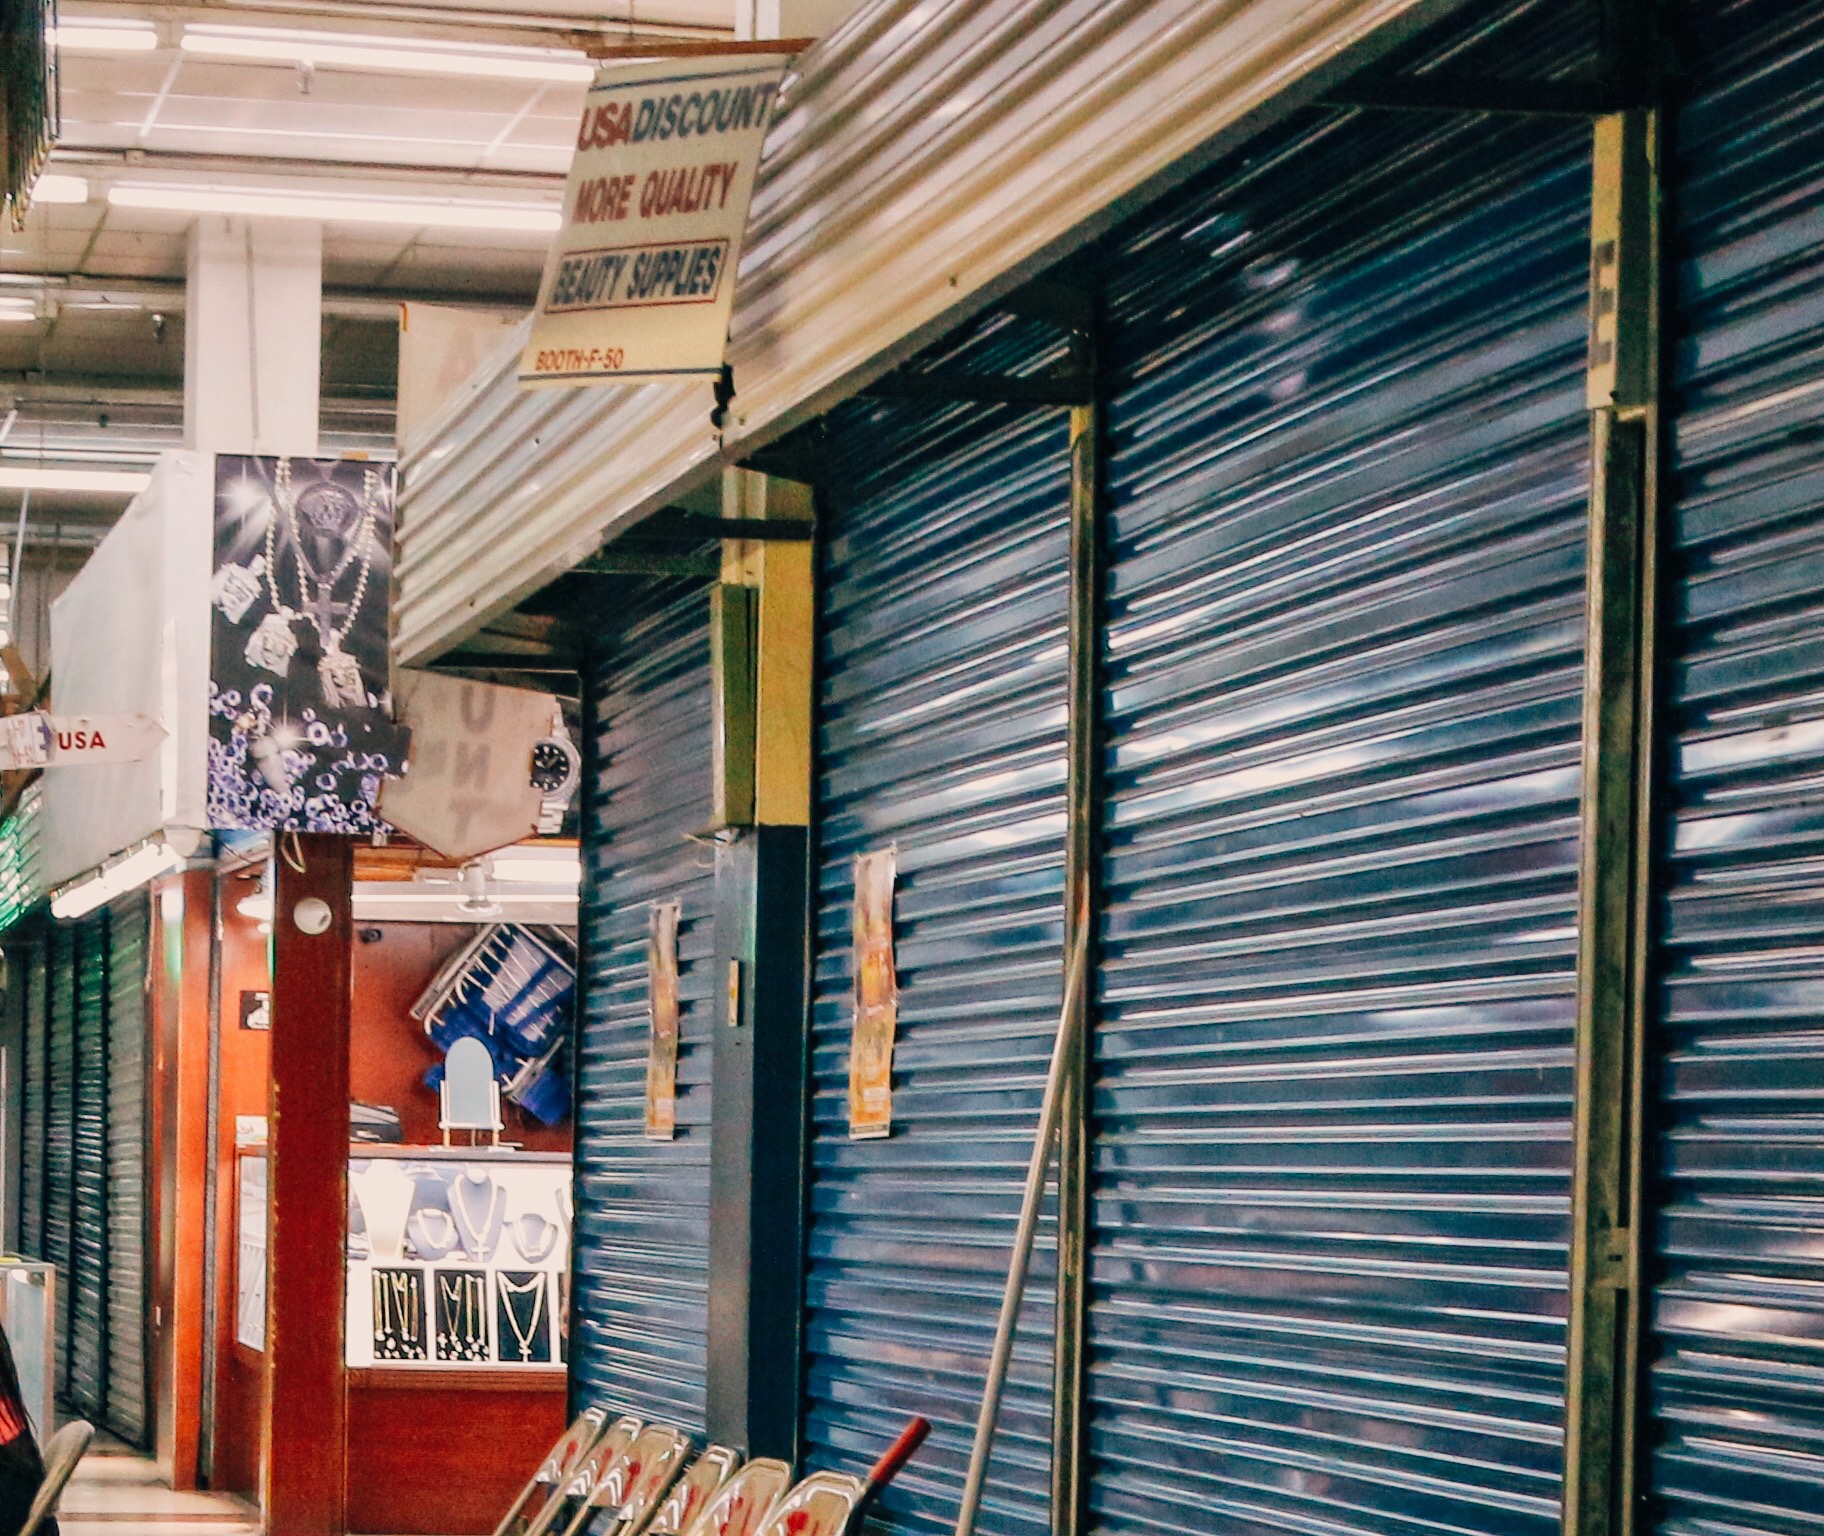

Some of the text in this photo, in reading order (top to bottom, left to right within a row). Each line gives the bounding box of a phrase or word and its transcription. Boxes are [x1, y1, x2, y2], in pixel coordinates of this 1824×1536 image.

[573, 161, 738, 224] MORE QUALITY
[553, 246, 721, 304] BEAUTY SUPPLIES
[58, 731, 106, 750] USA
